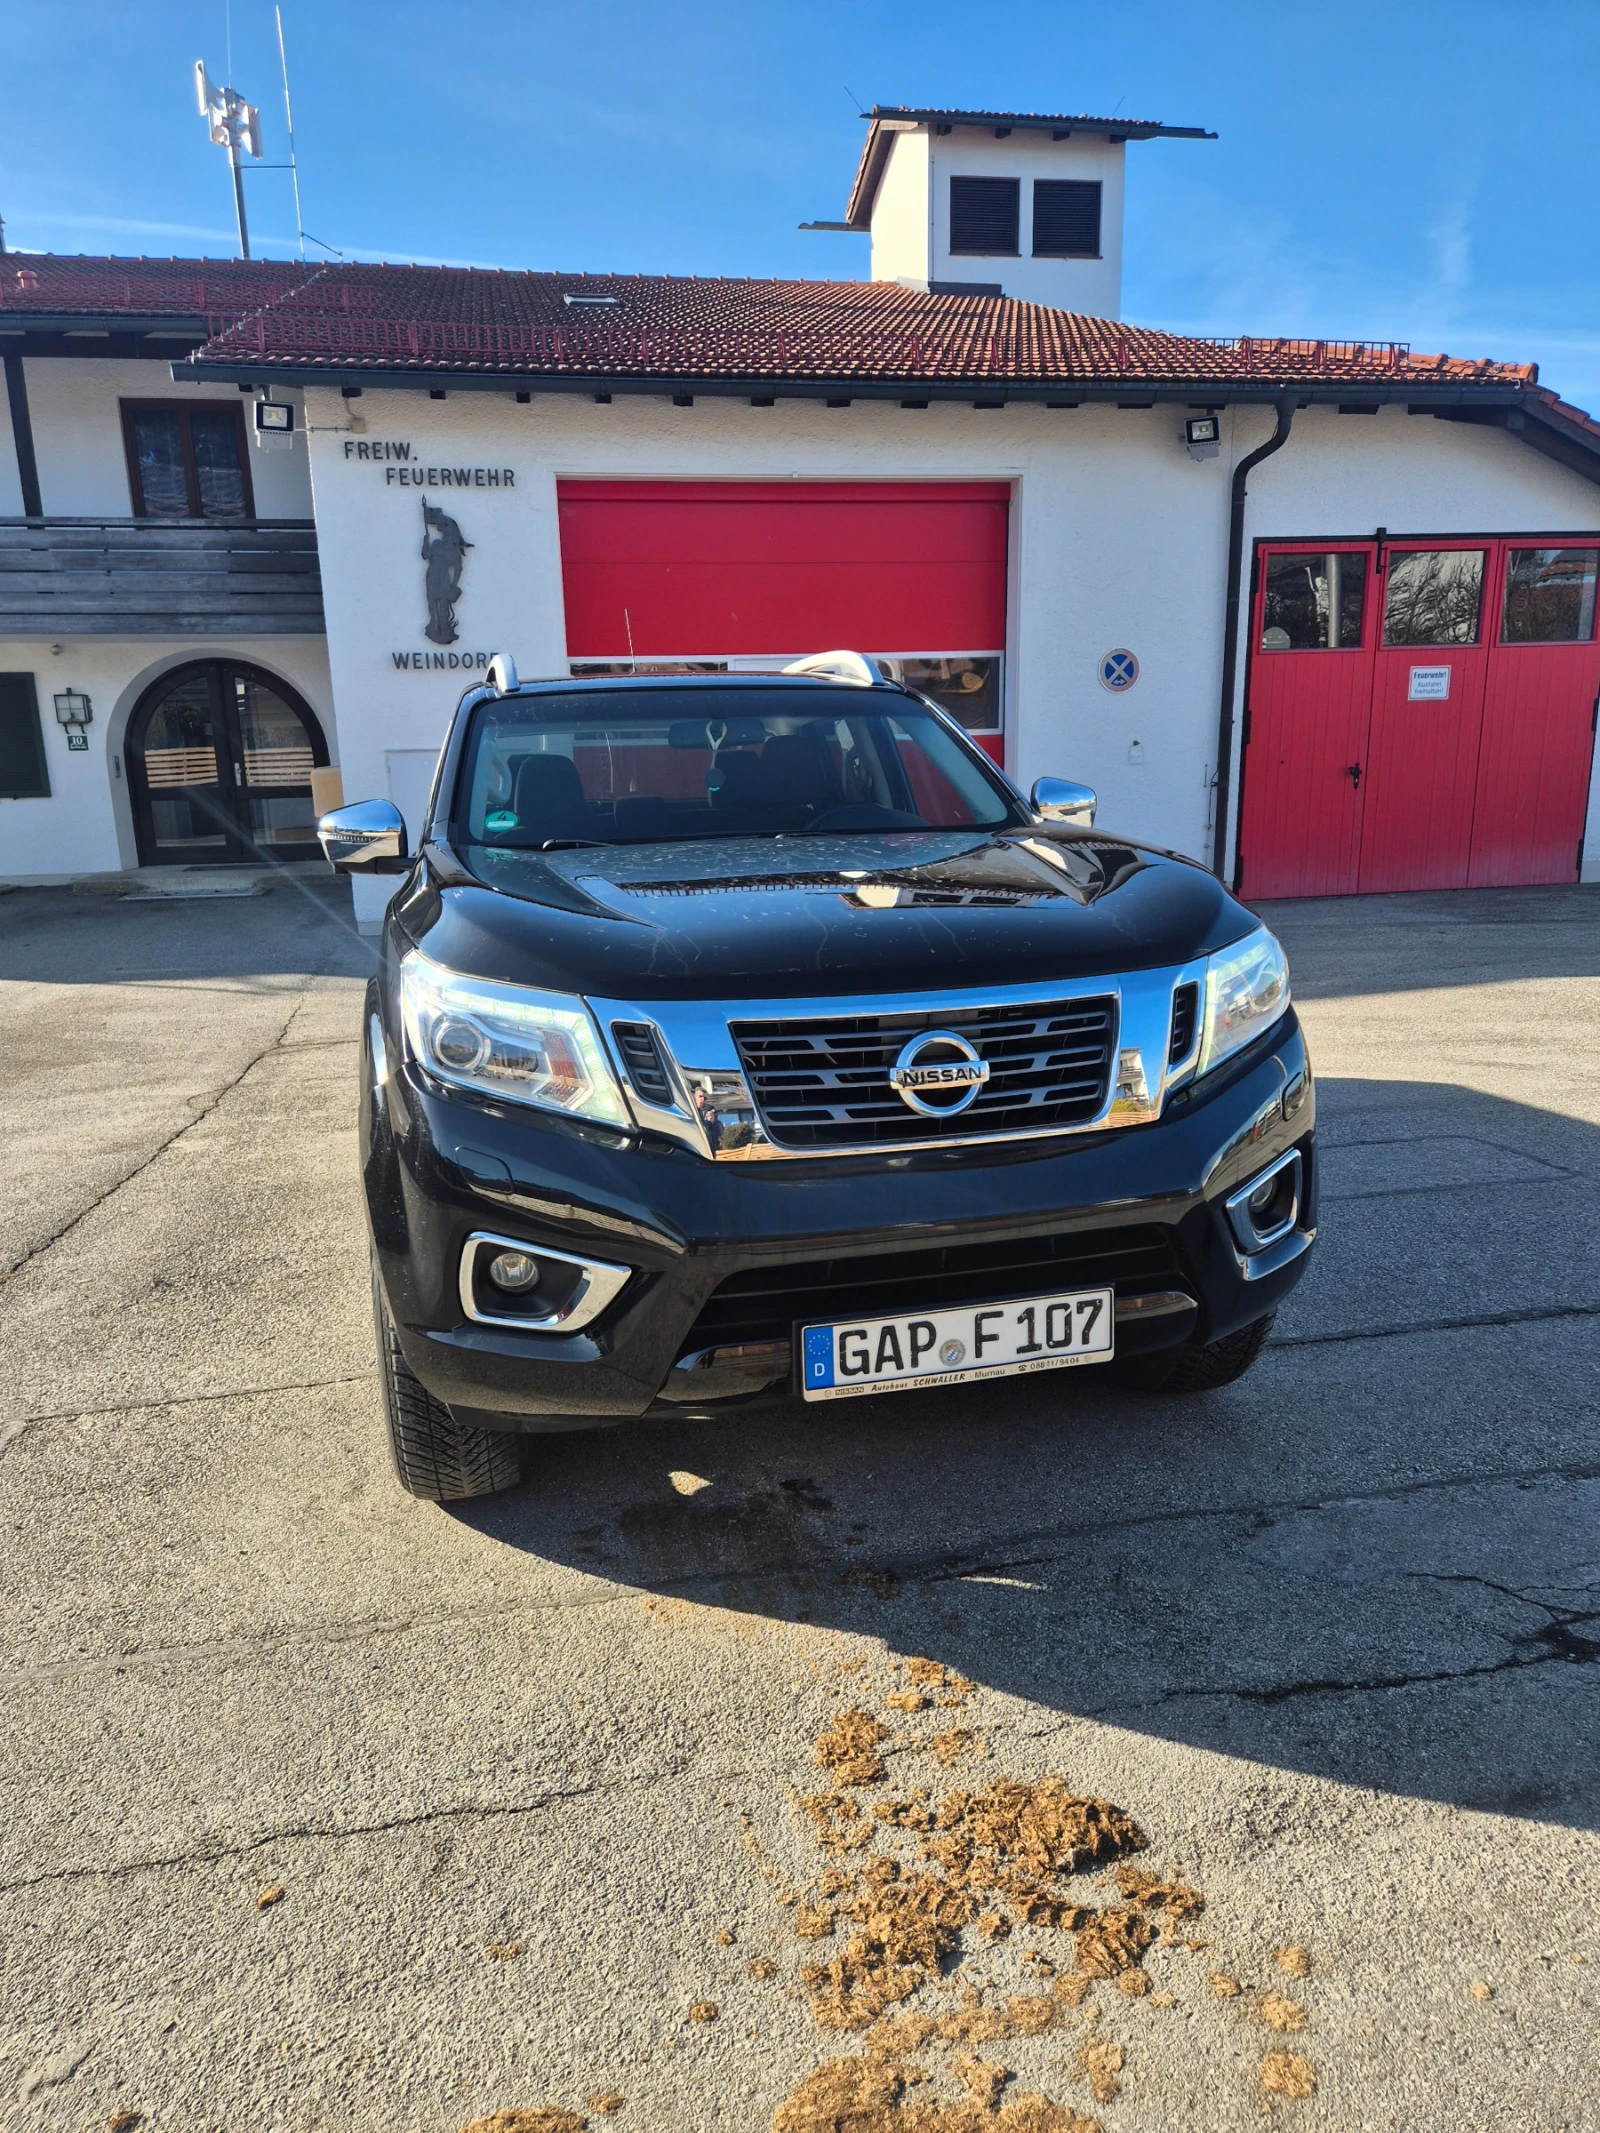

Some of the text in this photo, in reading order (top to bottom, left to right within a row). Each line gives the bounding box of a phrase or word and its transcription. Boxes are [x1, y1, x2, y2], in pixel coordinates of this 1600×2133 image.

[344, 441, 418, 461] FREIW.
[386, 467, 515, 487] FEUERWEHR
[72, 736, 83, 744] 10
[497, 811, 507, 821] 4
[902, 1066, 982, 1086] NISSAN
[838, 1320, 937, 1377] GAP
[974, 1310, 1004, 1359] F
[1016, 1298, 1103, 1355] 107
[814, 1362, 826, 1377] D
[871, 1382, 908, 1392] Autohaus
[913, 1373, 966, 1387] SCHWALLER
[974, 1368, 1006, 1379] Murnau
